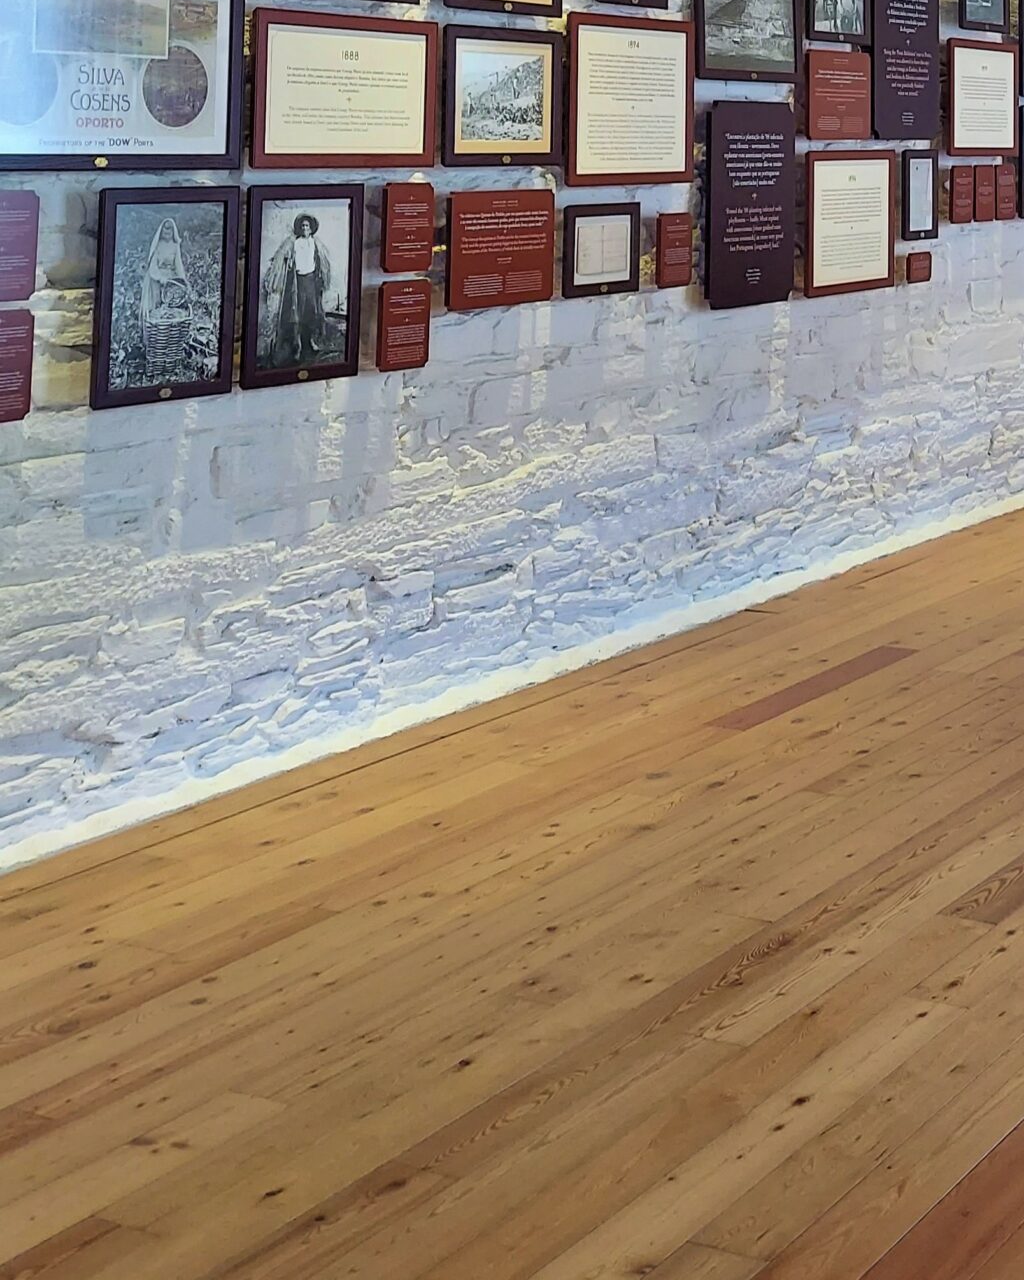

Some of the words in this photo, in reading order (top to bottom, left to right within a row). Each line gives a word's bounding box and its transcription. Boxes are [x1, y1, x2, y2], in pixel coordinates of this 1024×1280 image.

[341, 50, 359, 61] 1888
[78, 64, 125, 86] SILVA
[70, 89, 131, 113] COSENS
[75, 116, 125, 129] OPORTO
